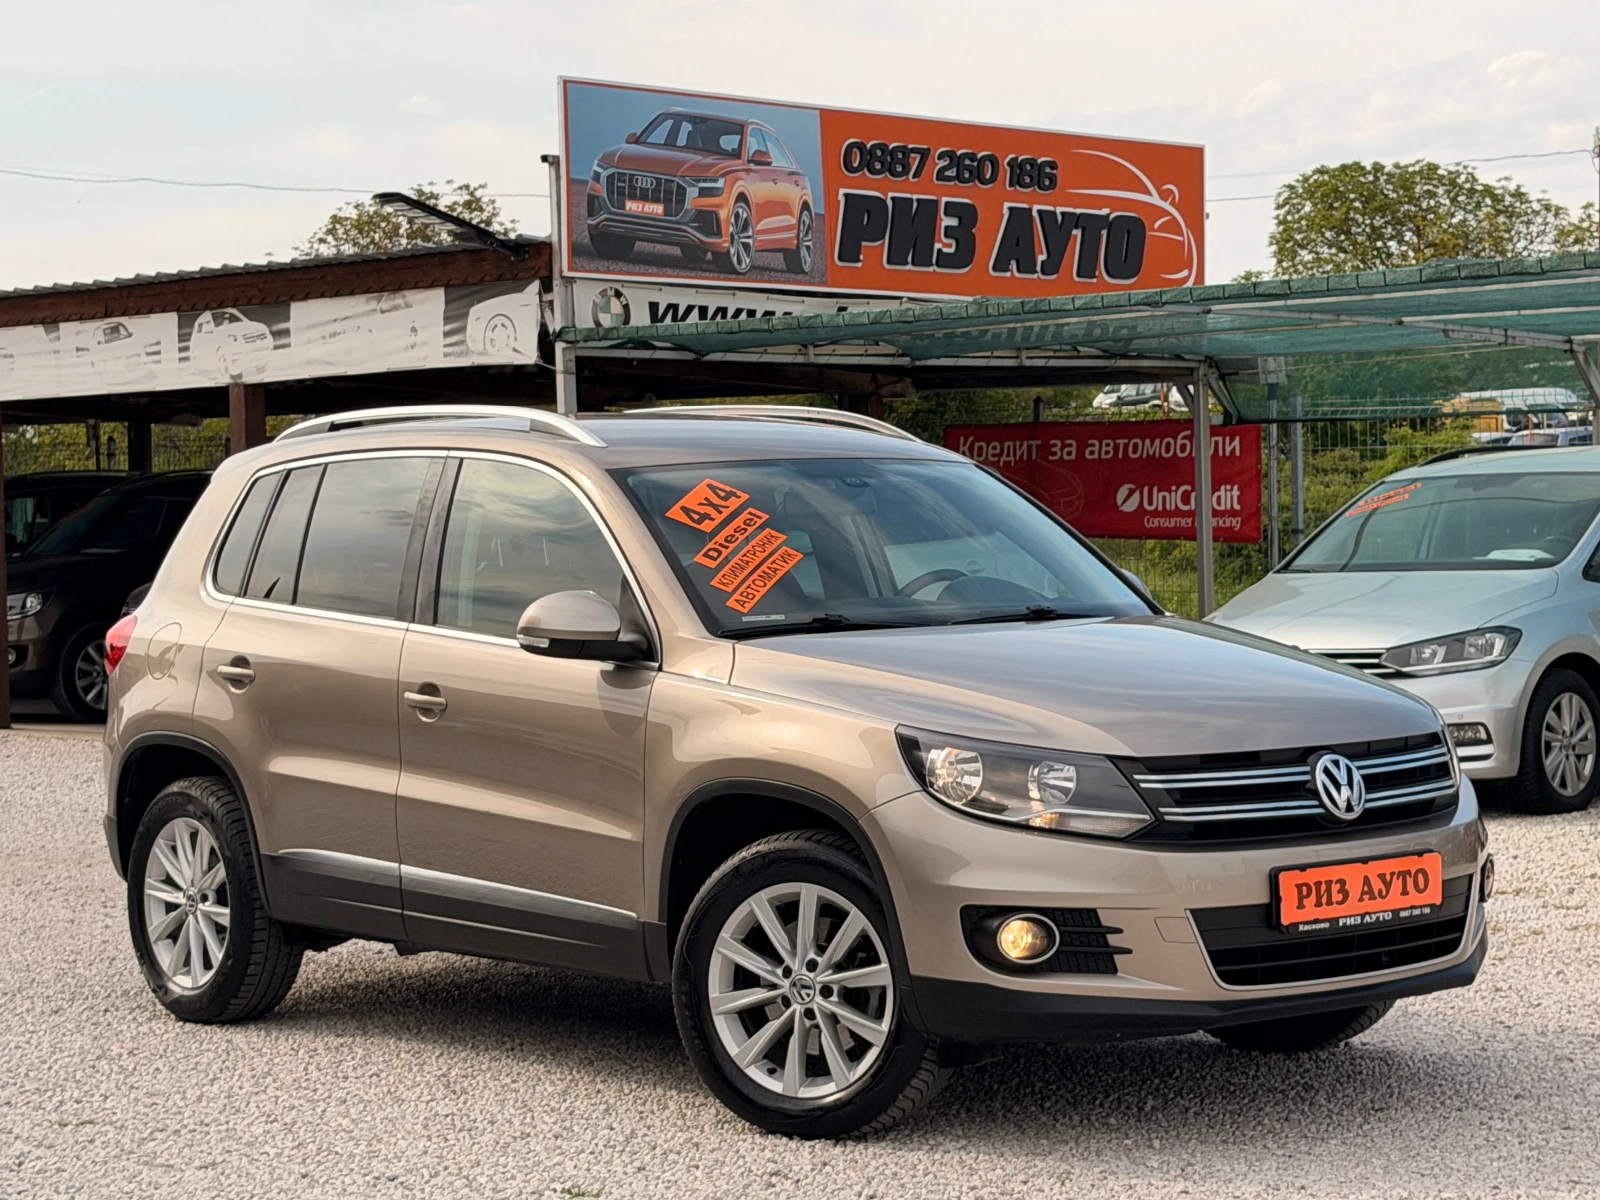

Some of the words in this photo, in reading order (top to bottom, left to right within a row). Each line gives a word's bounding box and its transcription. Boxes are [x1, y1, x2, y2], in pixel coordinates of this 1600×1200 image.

[841, 138, 931, 181] 0887
[933, 147, 1000, 188] 260
[1004, 154, 1058, 194] 186
[834, 188, 978, 274] РИЗ
[989, 202, 1147, 285] АУТО
[959, 436, 1041, 466] Кредит
[1048, 439, 1077, 460] за
[1085, 430, 1240, 459] автомобли
[1143, 484, 1240, 511] UniCrdit
[702, 511, 763, 562] Diesel
[1144, 515, 1193, 528] Consumer
[717, 531, 780, 588] КЛИМАТРОНИК
[734, 550, 798, 609] АВТОМАТИК
[1294, 877, 1349, 910] РИЗ
[1357, 868, 1430, 902] АУТО
[1339, 915, 1361, 926] РИЗ
[1363, 911, 1392, 924] АУТО
